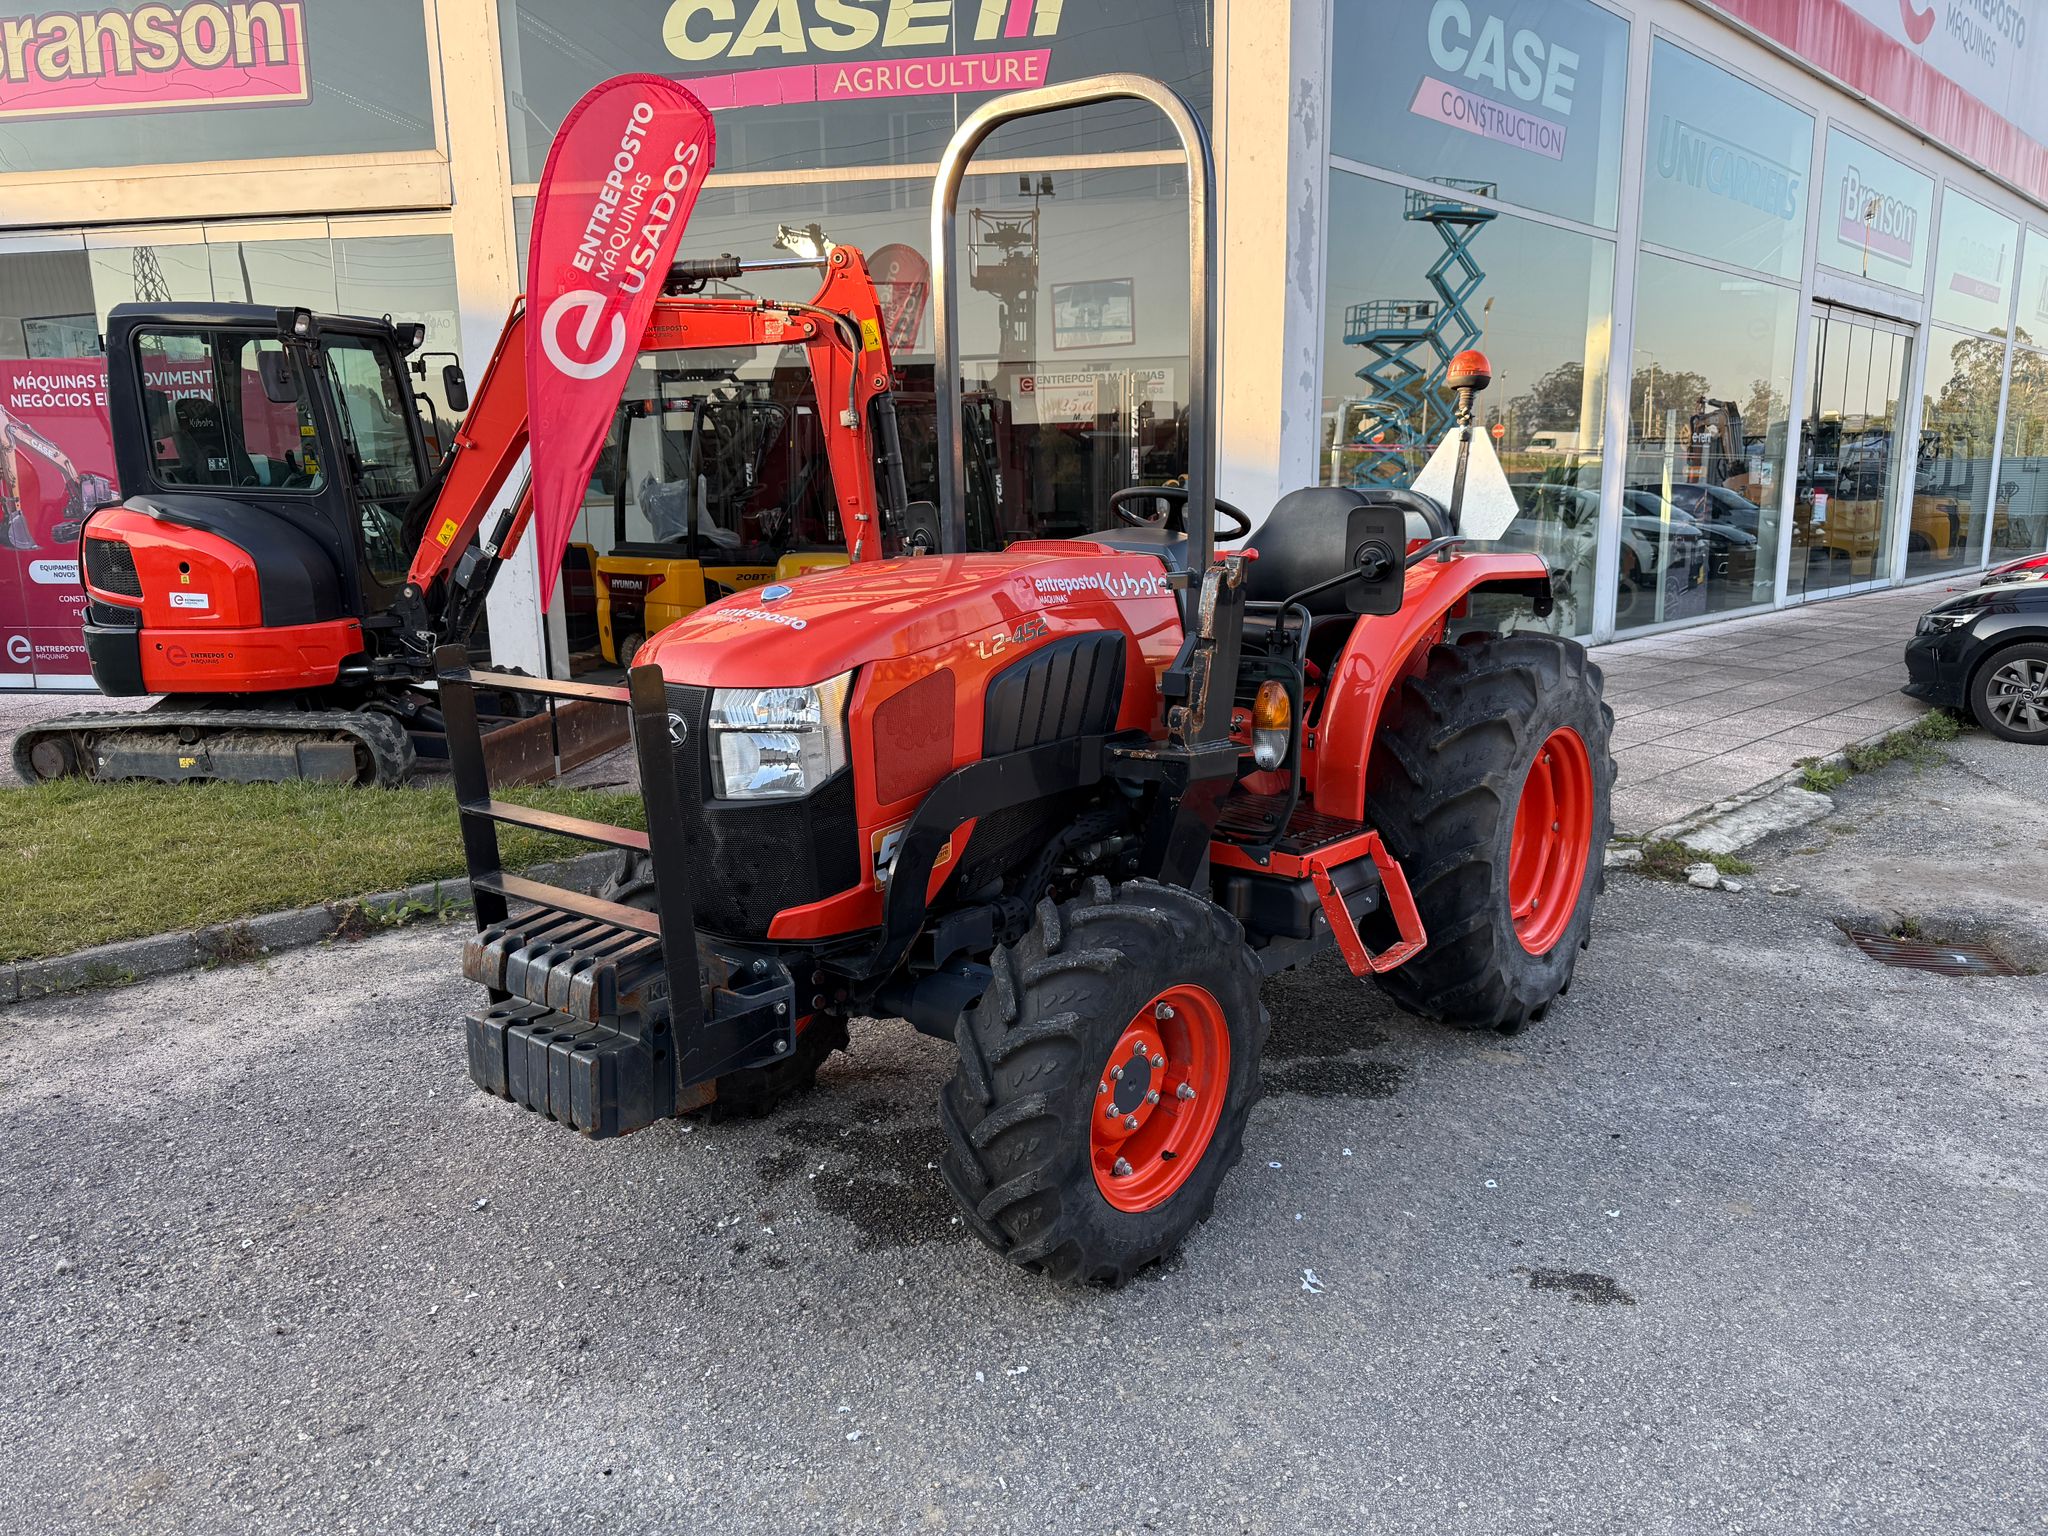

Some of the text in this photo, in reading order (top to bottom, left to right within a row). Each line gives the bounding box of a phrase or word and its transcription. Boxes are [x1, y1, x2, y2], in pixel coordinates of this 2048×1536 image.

[0, 0, 287, 82] ranson
[1428, 0, 1579, 115] CASE
[833, 56, 1039, 94] AGRICULTURE
[1441, 91, 1562, 154] CONSTRUCTION
[572, 102, 654, 273] ENTREPOSTO
[1657, 115, 1800, 222] UNICARRIERS
[595, 171, 651, 282] MÁQUINAS
[619, 140, 699, 294] USADOS
[645, 325, 688, 333] NTREPOSTO
[11, 391, 108, 408] NEGÓCIOS E
[13, 370, 97, 392] MÁQUINAS
[144, 370, 212, 387] OVIMENT
[59, 595, 87, 603] CONST
[611, 578, 643, 590] HYUNDAI
[1034, 574, 1098, 595] entreposto
[715, 607, 807, 630] entreposto
[34, 645, 86, 653] ENTREPOSTO
[978, 616, 1049, 660] L2-452
